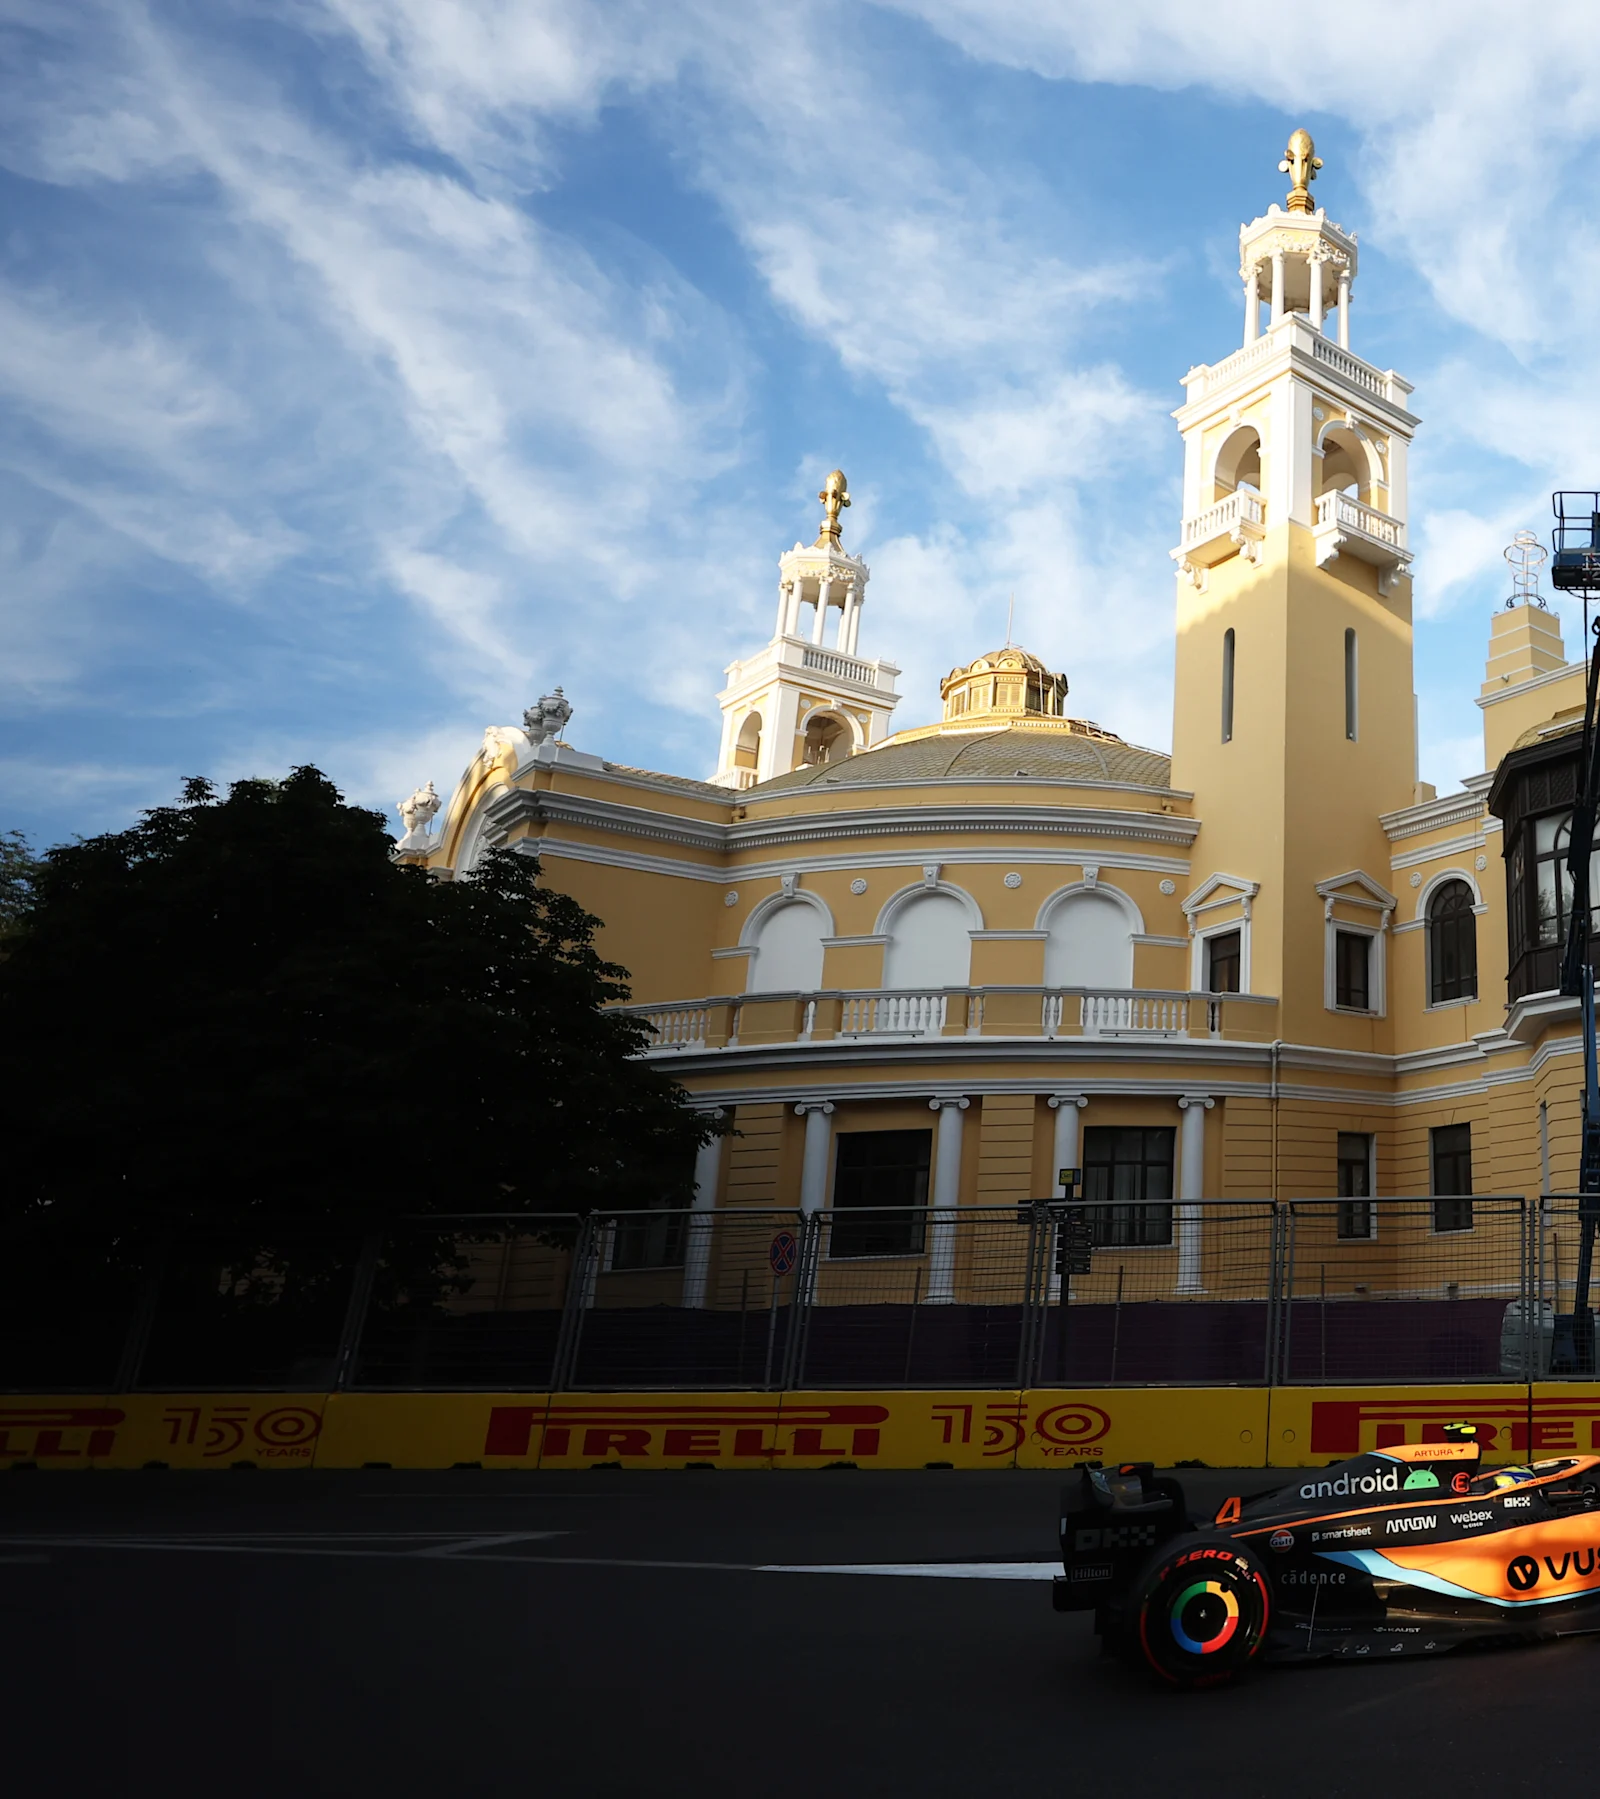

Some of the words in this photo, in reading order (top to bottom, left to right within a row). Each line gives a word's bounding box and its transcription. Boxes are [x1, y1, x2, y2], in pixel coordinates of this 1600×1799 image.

[484, 1405, 890, 1456] PIRELLI
[255, 1448, 311, 1457] YEARS
[1040, 1447, 1103, 1456] YEARS
[1414, 1448, 1454, 1457] ARTURA
[1300, 1466, 1399, 1500] android
[1503, 1496, 1531, 1509] OKX
[1214, 1496, 1243, 1525] 4
[1450, 1509, 1494, 1525] webex
[1322, 1526, 1372, 1540] smartsheet
[1175, 1548, 1235, 1569] ZERO
[1074, 1567, 1110, 1579] Hilton
